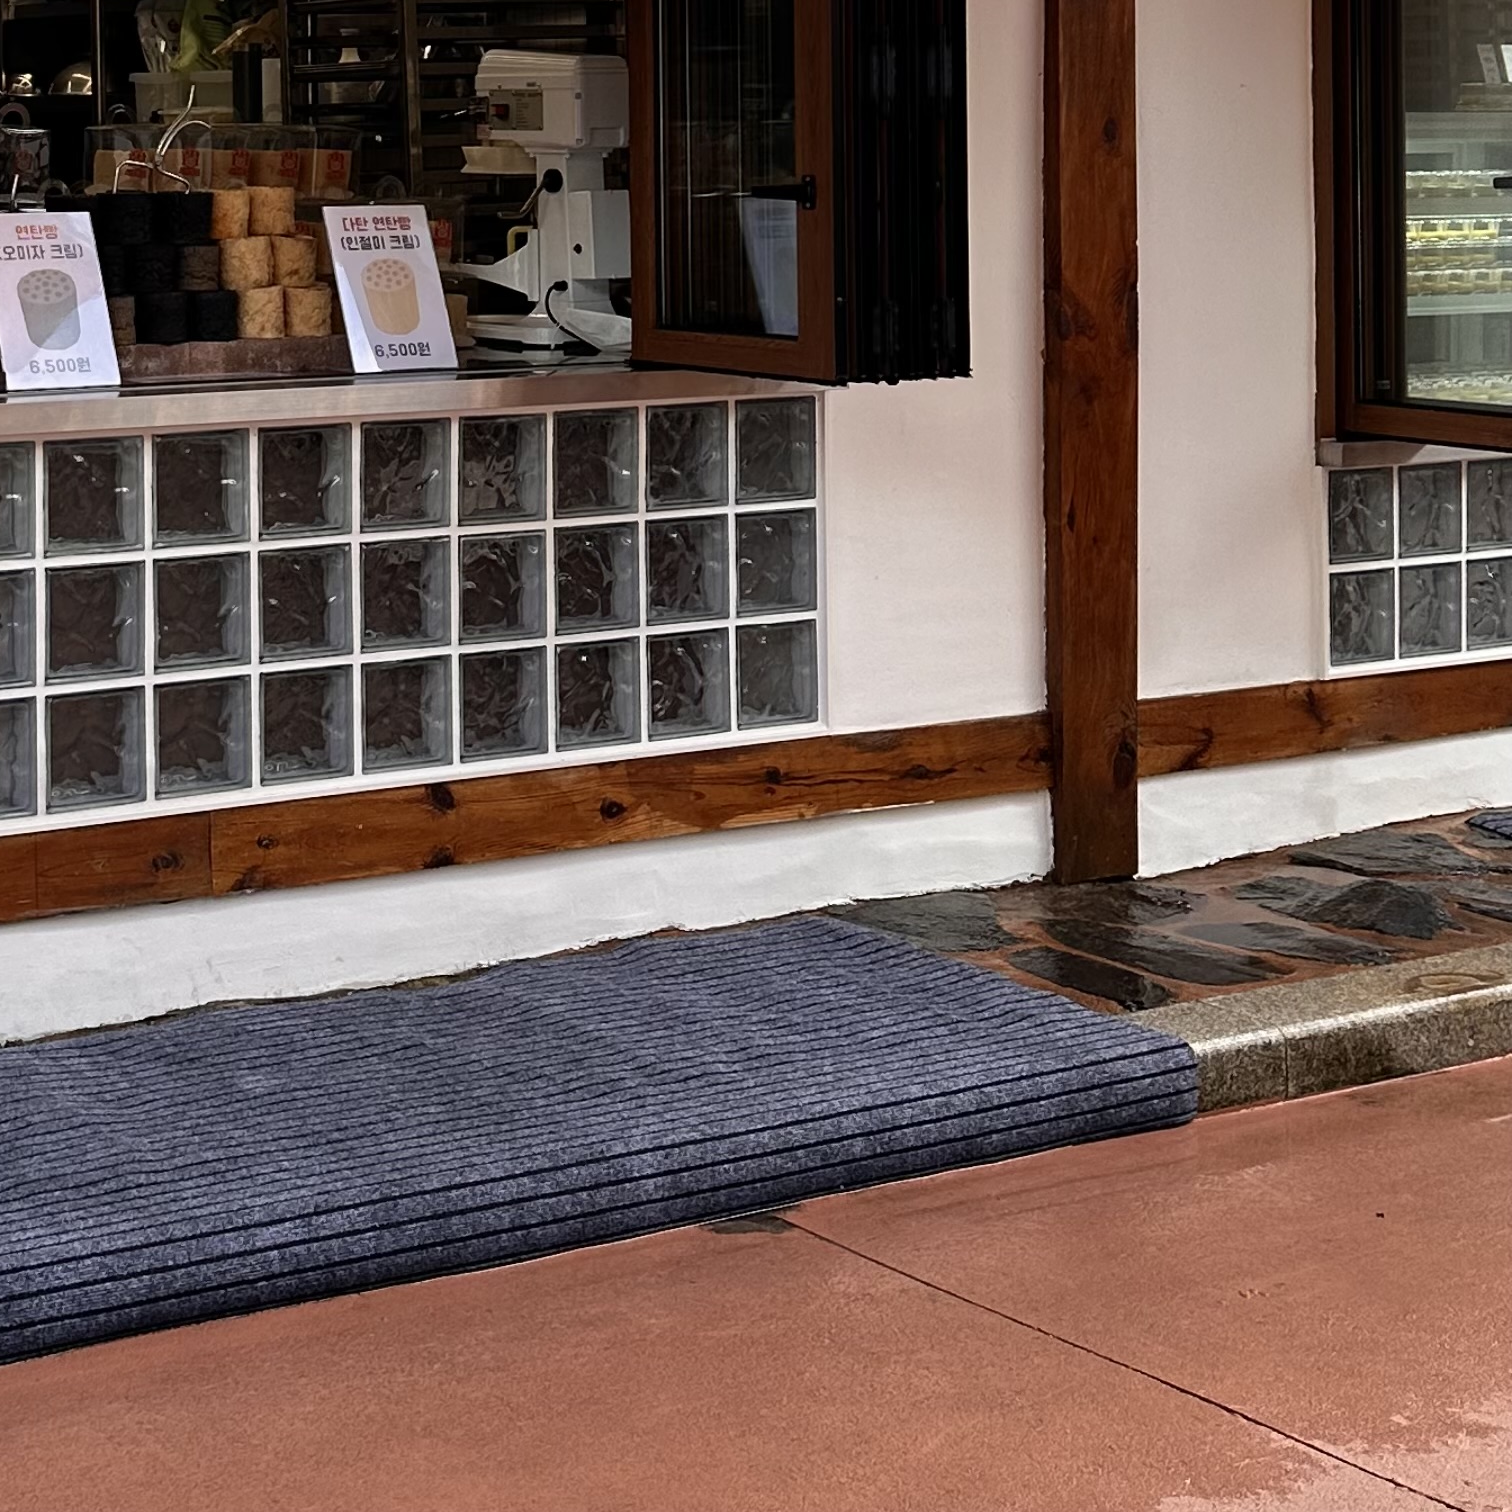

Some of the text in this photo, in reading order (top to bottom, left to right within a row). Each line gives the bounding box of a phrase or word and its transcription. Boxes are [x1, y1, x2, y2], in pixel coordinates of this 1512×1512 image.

[371, 216, 411, 231] 연탄빵
[15, 225, 58, 240] 연탄빵
[340, 235, 421, 251] (인절미 크림)
[51, 243, 84, 260] 크림)
[374, 341, 432, 359] 6,500원
[29, 356, 92, 375] 6,500원
